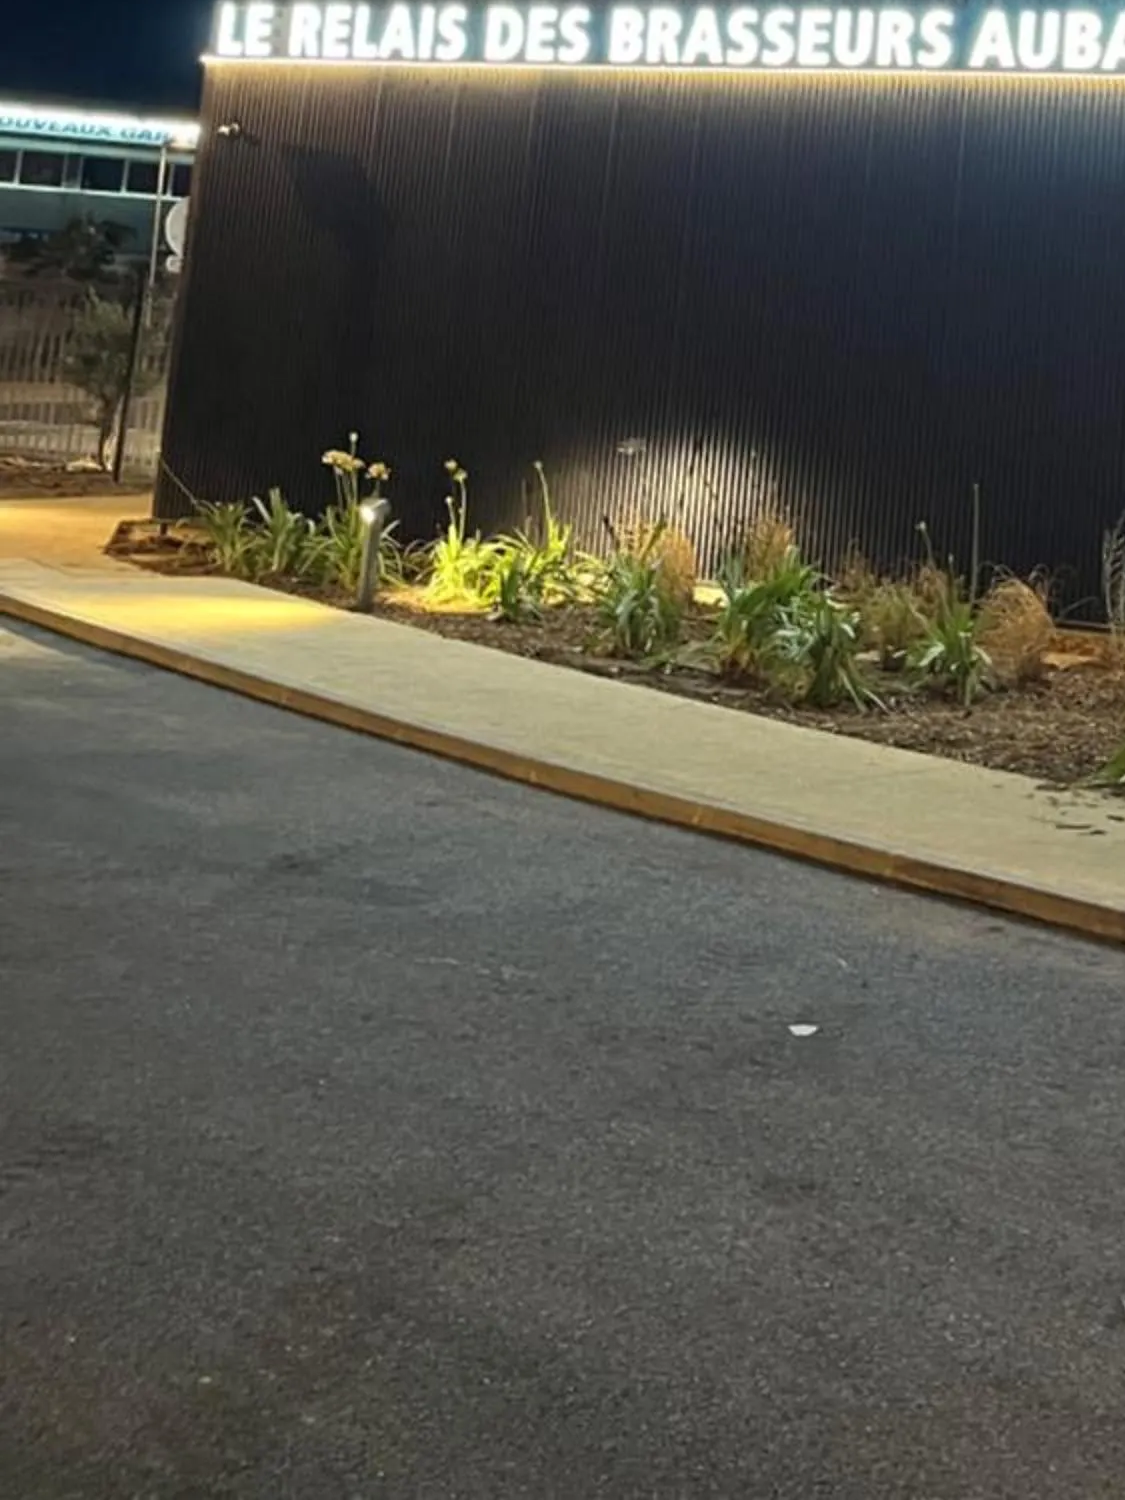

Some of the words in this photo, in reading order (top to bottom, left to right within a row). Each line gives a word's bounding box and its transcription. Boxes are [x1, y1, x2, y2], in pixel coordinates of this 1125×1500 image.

[215, 0, 272, 57] LE
[288, 1, 468, 60] RELAIS
[483, 4, 591, 62] DES
[607, 6, 955, 67] BRASSEURS
